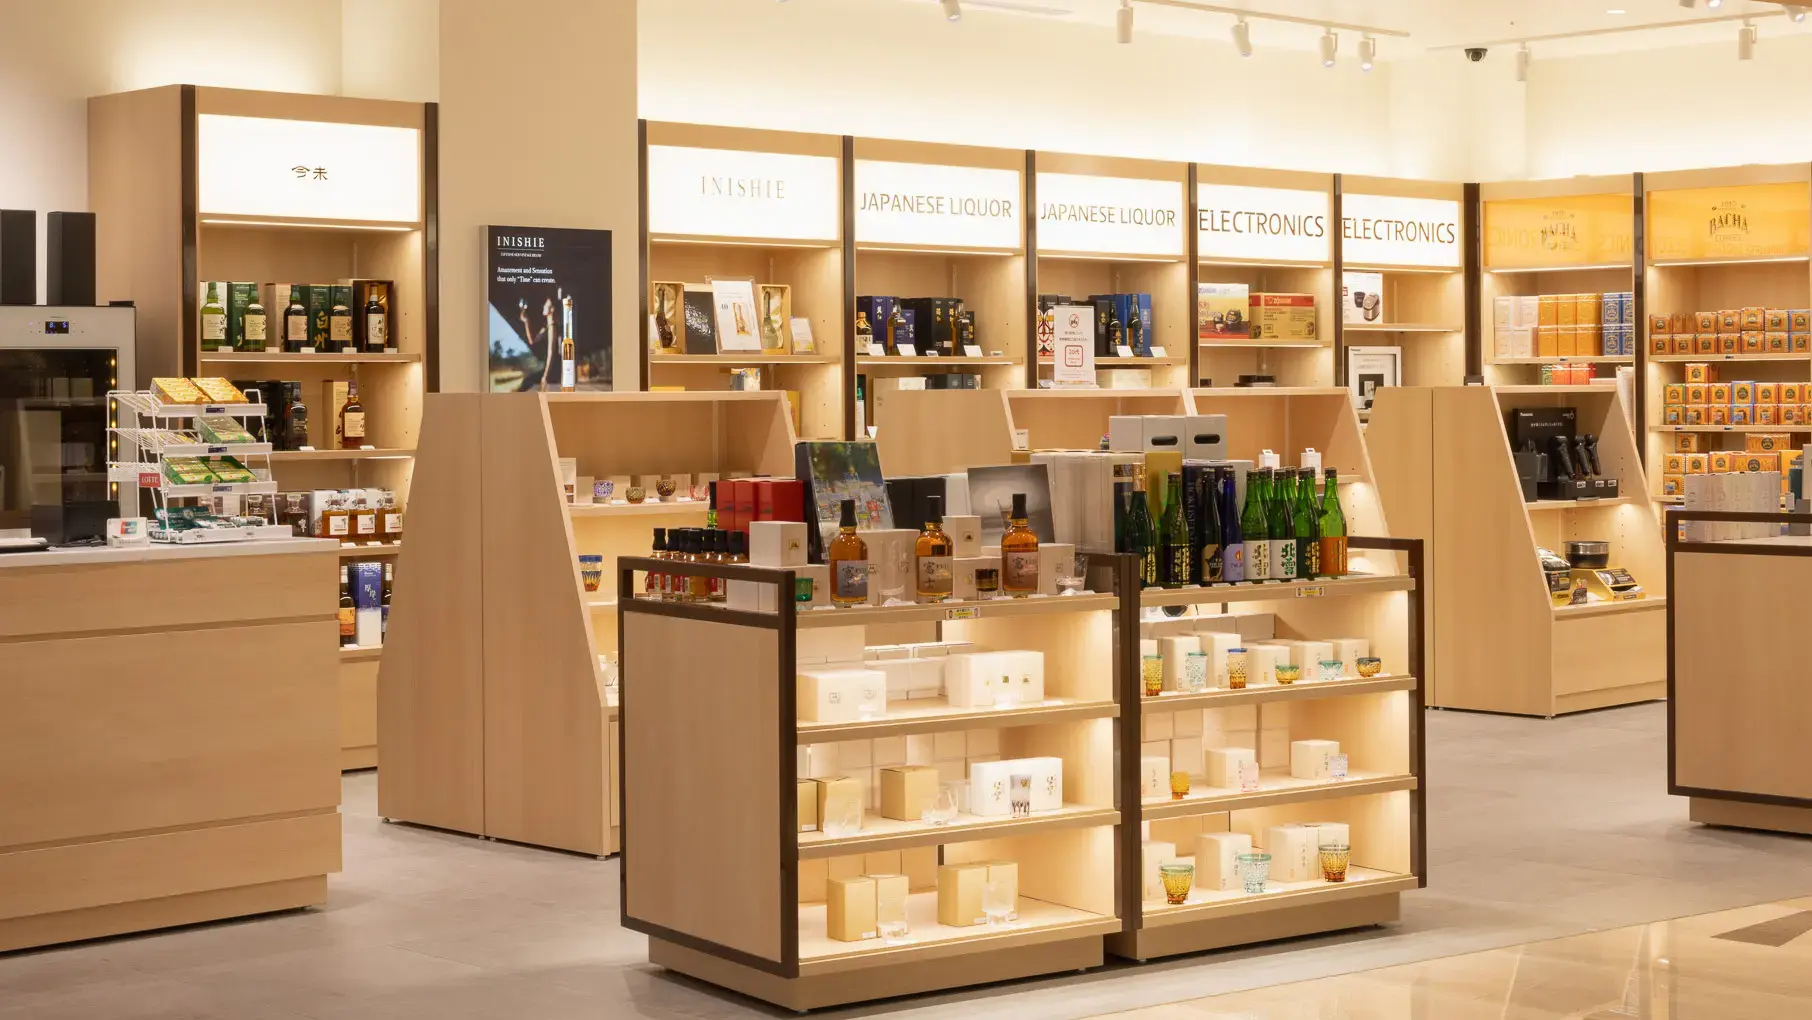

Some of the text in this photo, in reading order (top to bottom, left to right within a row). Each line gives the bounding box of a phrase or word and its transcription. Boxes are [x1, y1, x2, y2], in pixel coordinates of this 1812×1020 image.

[701, 175, 785, 199] INISHIE
[860, 192, 1012, 217] JAPANESE LIQUOR
[1040, 202, 1176, 226] JAPANESE LIQUOR
[1198, 208, 1324, 237] ELECTRONICS
[1342, 217, 1455, 244] ELECTRONICS
[1709, 212, 1749, 236] BACHA
[497, 236, 545, 248] INISHIE
[507, 276, 516, 284] only
[314, 311, 329, 348] 白州
[141, 476, 159, 484] LOTTE
